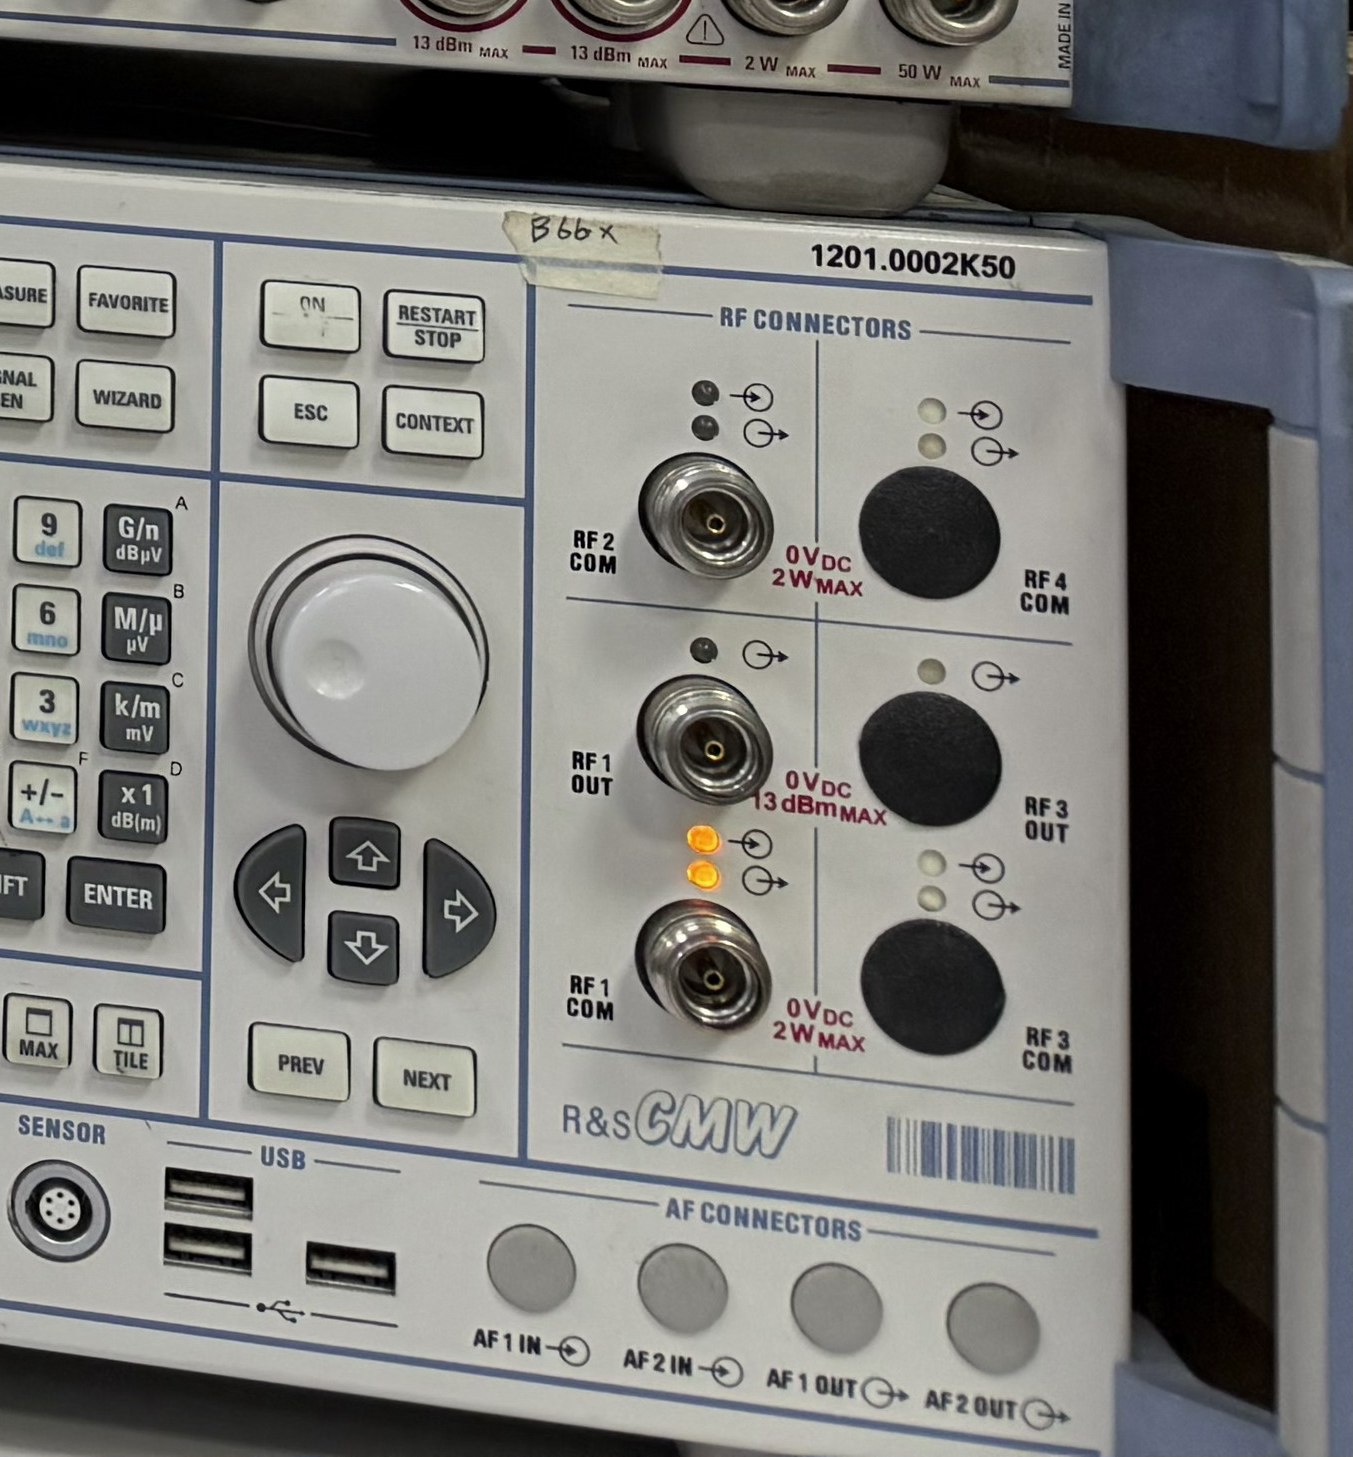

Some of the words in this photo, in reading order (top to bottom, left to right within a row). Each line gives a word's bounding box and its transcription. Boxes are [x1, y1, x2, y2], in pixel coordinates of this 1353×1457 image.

[1058, 3, 1071, 19] IN
[1058, 24, 1071, 69] MADE
[811, 243, 1016, 280] 1201.0002K50
[88, 291, 169, 314] FAVORITE
[398, 304, 477, 327] RESTART
[720, 306, 748, 328] RF
[753, 308, 912, 341] CONNECTORS
[414, 328, 462, 349] STOP
[92, 388, 163, 410] WIZARD
[294, 402, 329, 422] ESC
[395, 412, 475, 435] CONTEXT
[84, 882, 153, 911] ENTER
[19, 1038, 59, 1061] MAX
[113, 1049, 149, 1075] TILE
[278, 1053, 325, 1076] PREV
[403, 1068, 452, 1092] NEXT
[18, 1114, 106, 1146] SENSOR
[260, 1145, 306, 1171] USB
[665, 1197, 695, 1221] AF
[700, 1201, 862, 1243] CONNECTORS
